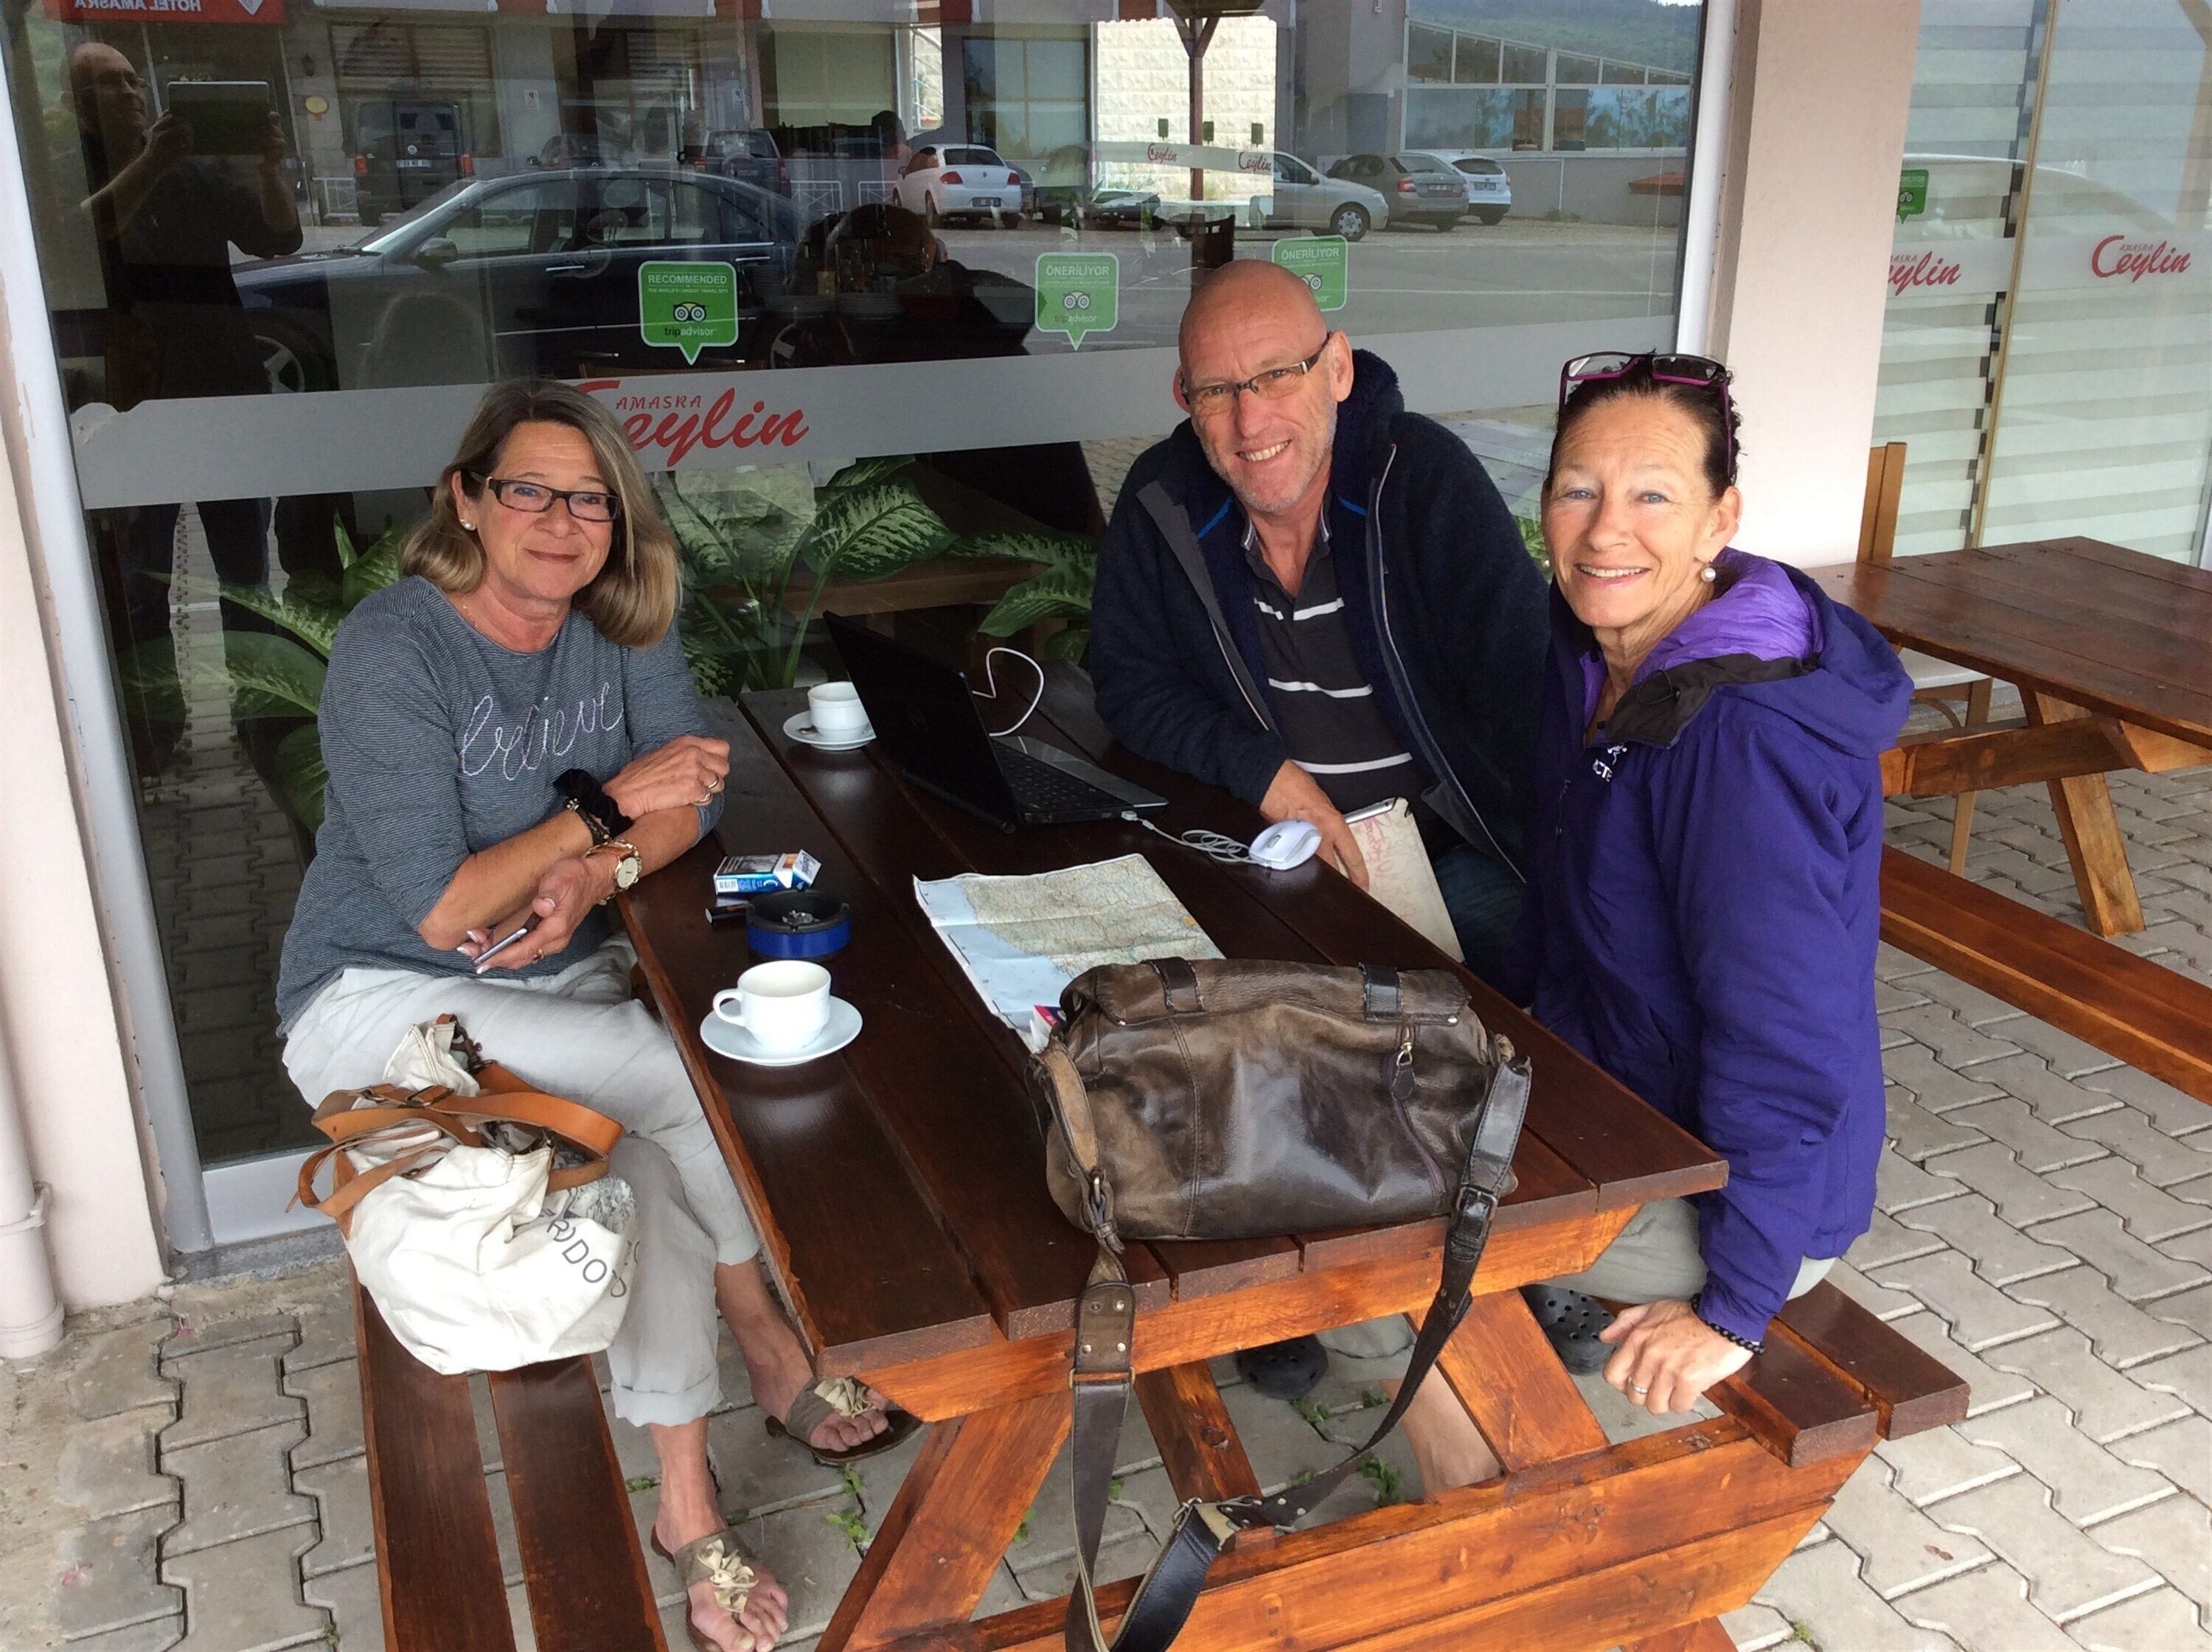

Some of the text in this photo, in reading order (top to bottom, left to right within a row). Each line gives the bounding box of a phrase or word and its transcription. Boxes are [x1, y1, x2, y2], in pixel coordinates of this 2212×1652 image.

[2092, 234, 2191, 283] Ceylin
[648, 274, 727, 285] RECOMMENDED
[1888, 250, 1961, 296] ylin
[664, 326, 714, 338] tripadvisor
[616, 395, 701, 411] AMASRA
